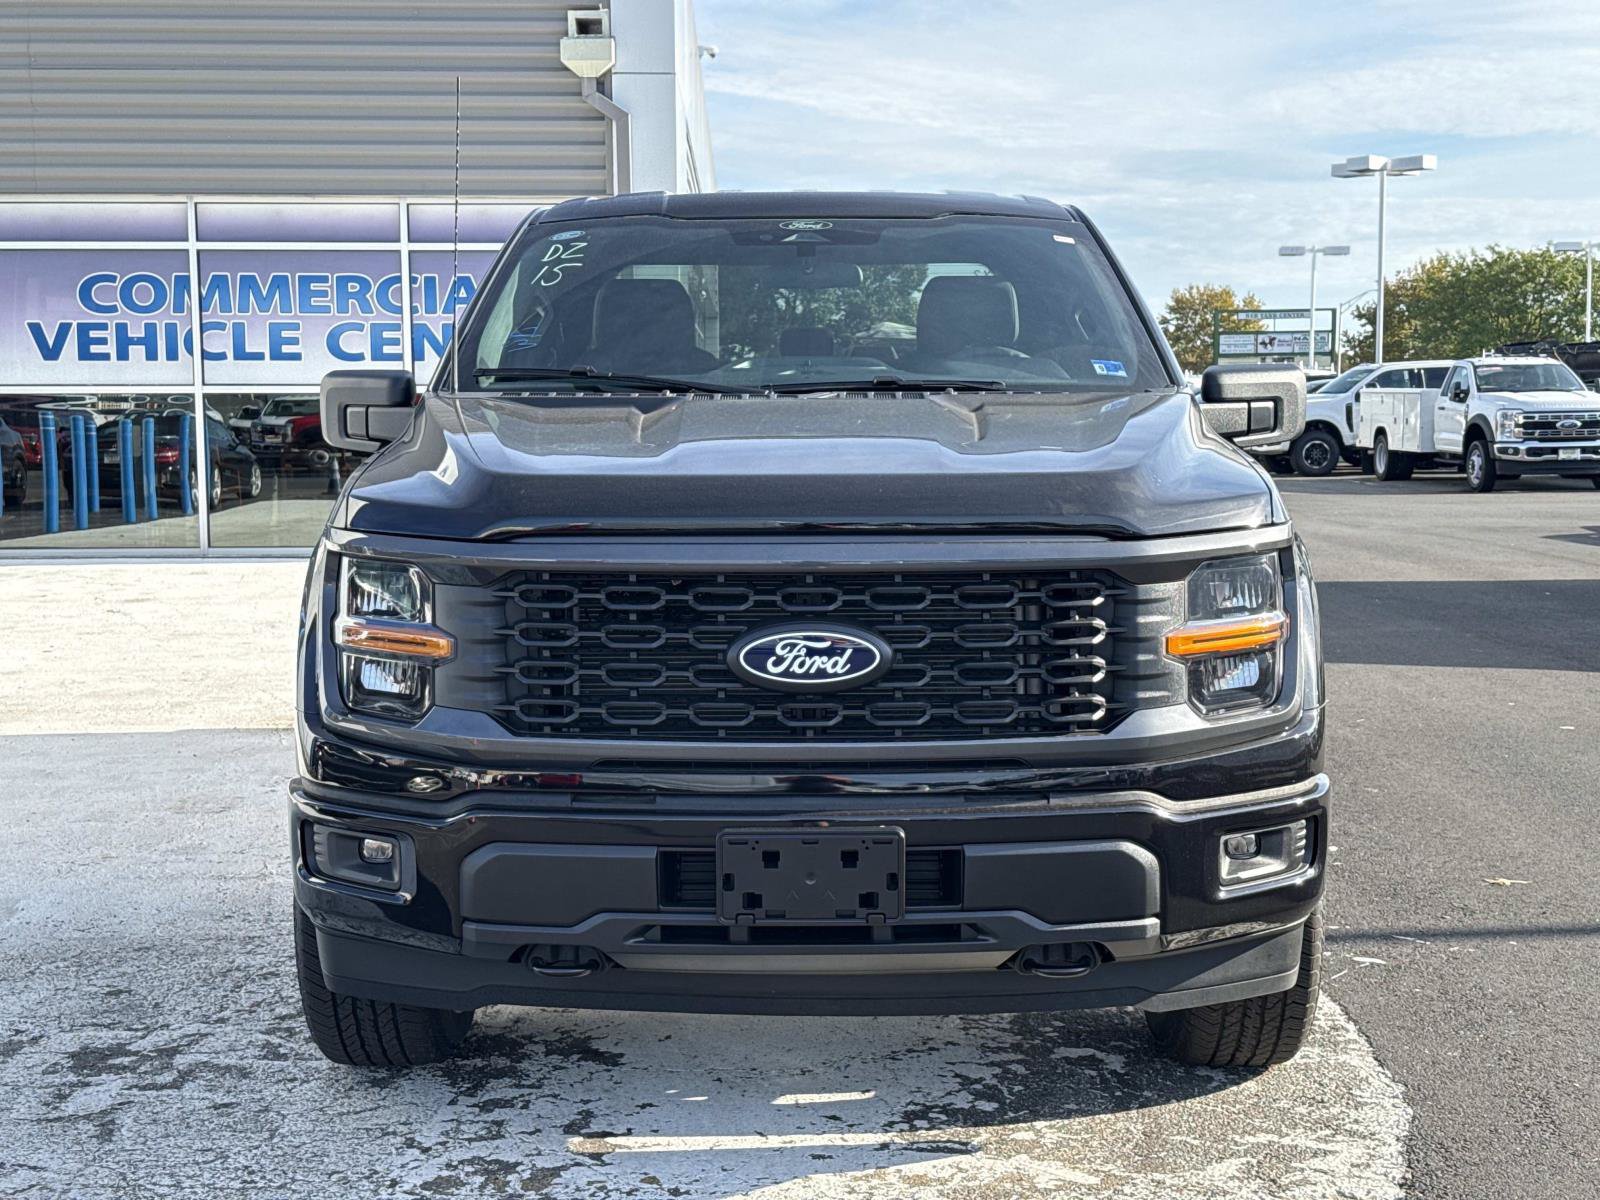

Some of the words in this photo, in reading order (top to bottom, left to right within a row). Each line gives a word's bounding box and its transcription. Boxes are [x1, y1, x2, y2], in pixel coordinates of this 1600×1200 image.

[788, 220, 825, 230] Ford
[541, 242, 588, 262] DZ
[25, 320, 302, 362] VEHICLE
[766, 639, 853, 674] Ford
